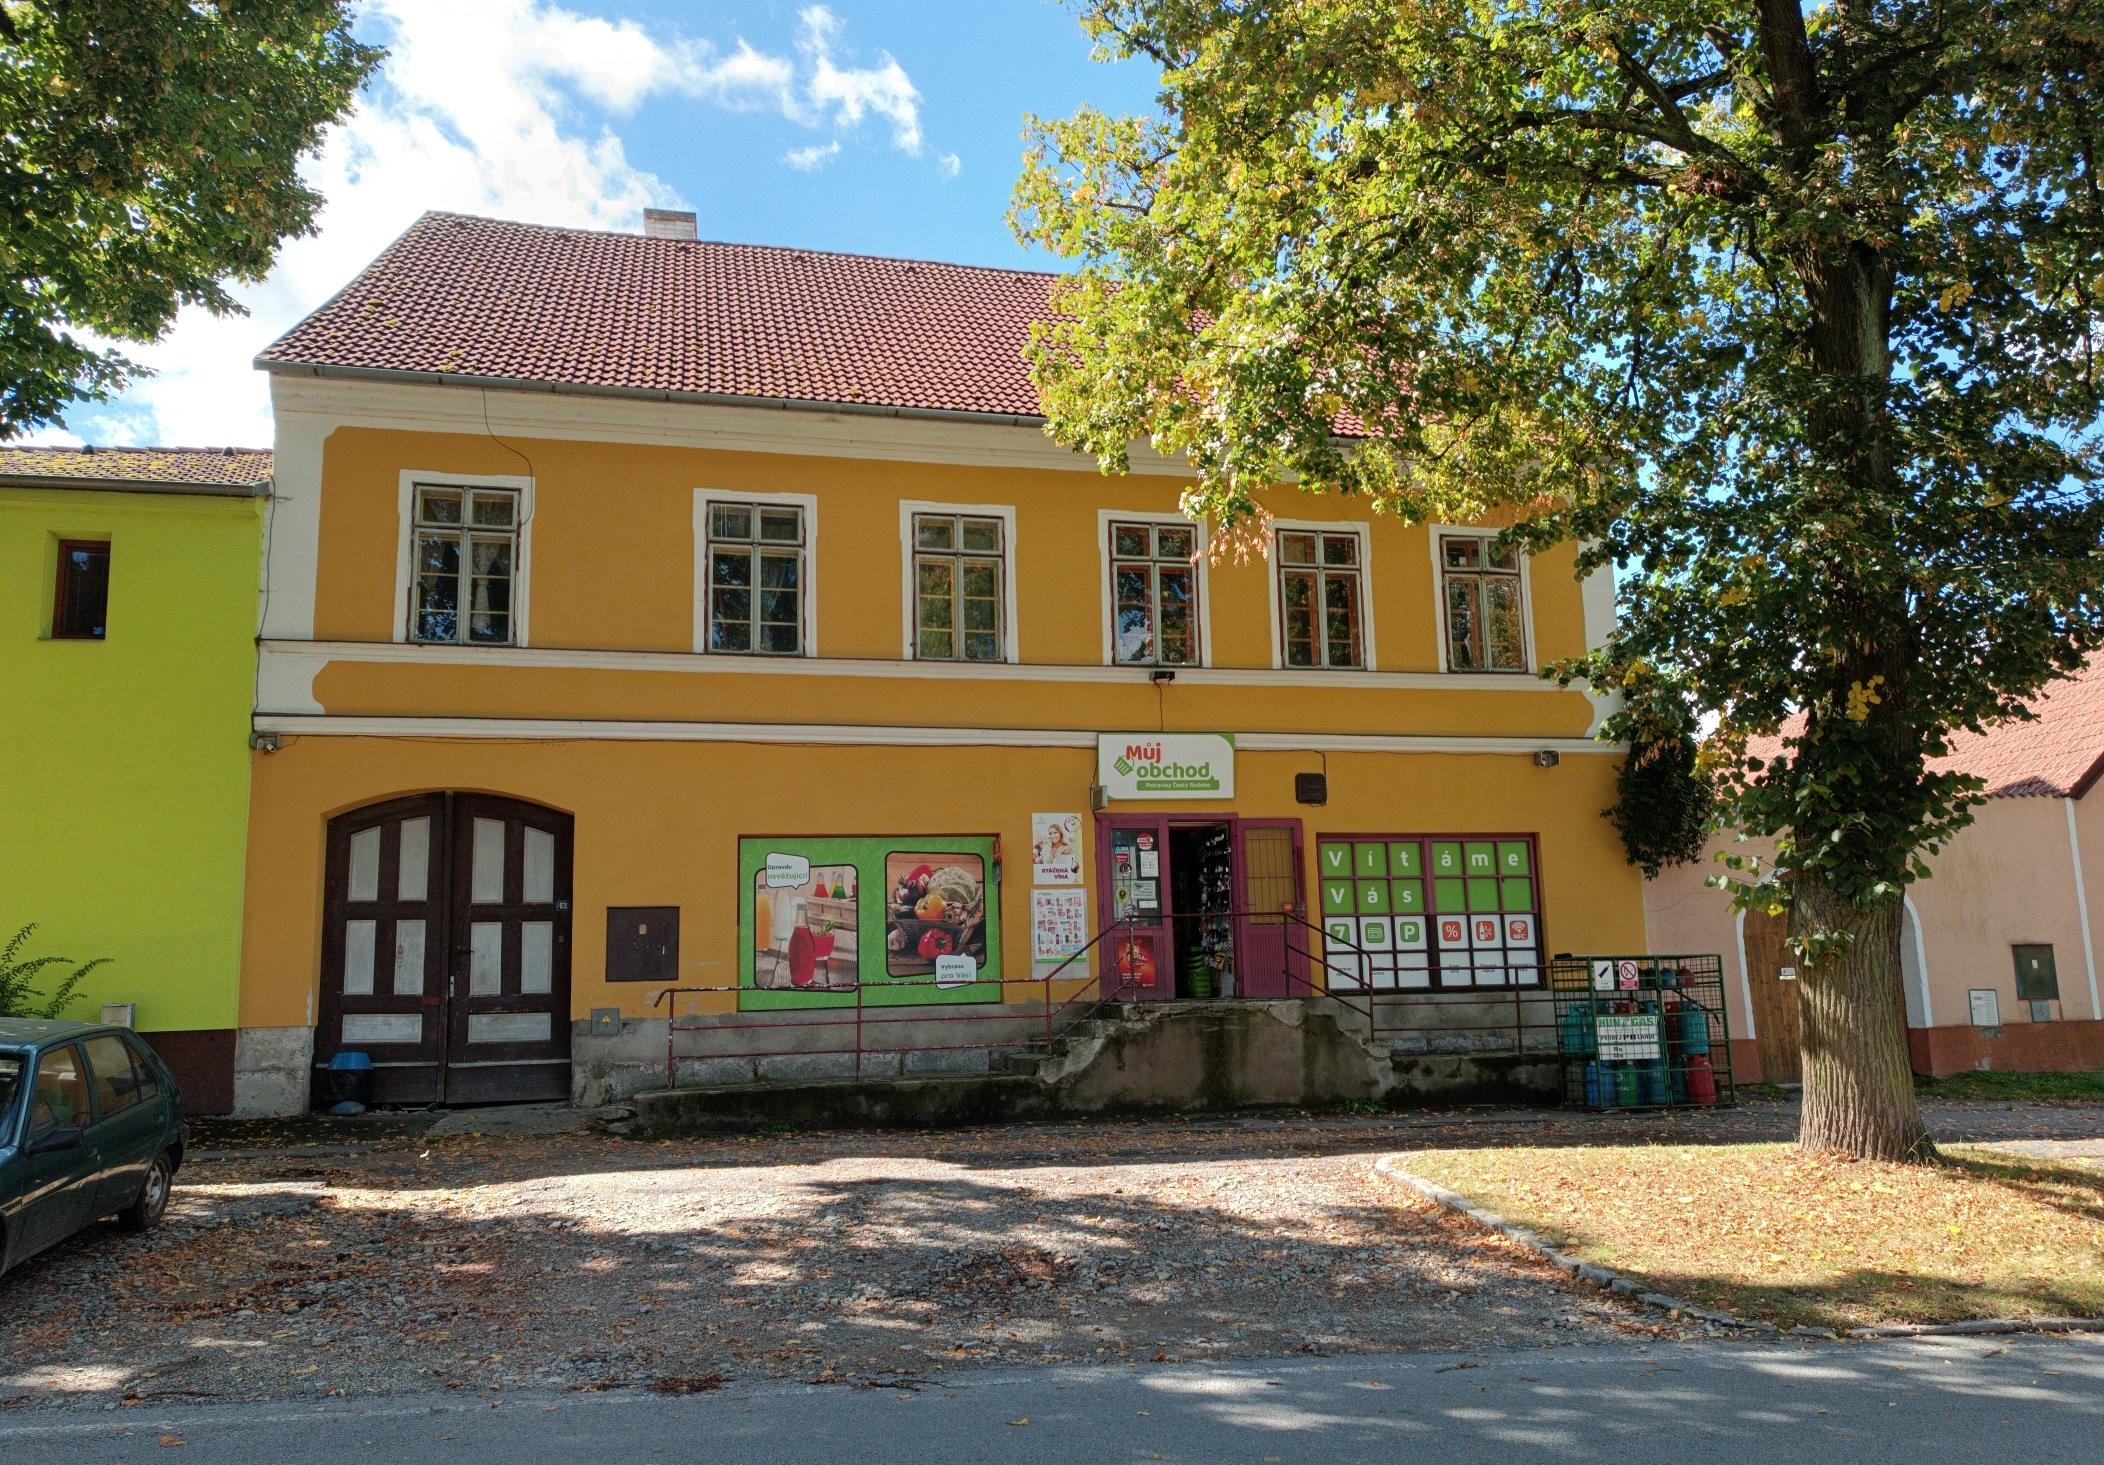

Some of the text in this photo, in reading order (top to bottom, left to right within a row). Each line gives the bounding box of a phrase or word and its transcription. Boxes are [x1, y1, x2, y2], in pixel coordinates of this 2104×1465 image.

[1126, 742, 1161, 763] Můj
[1136, 762, 1210, 778] obchod
[1328, 851, 1519, 867] Vítáme
[1330, 887, 1412, 904] Vás
[1404, 925, 1416, 939] P
